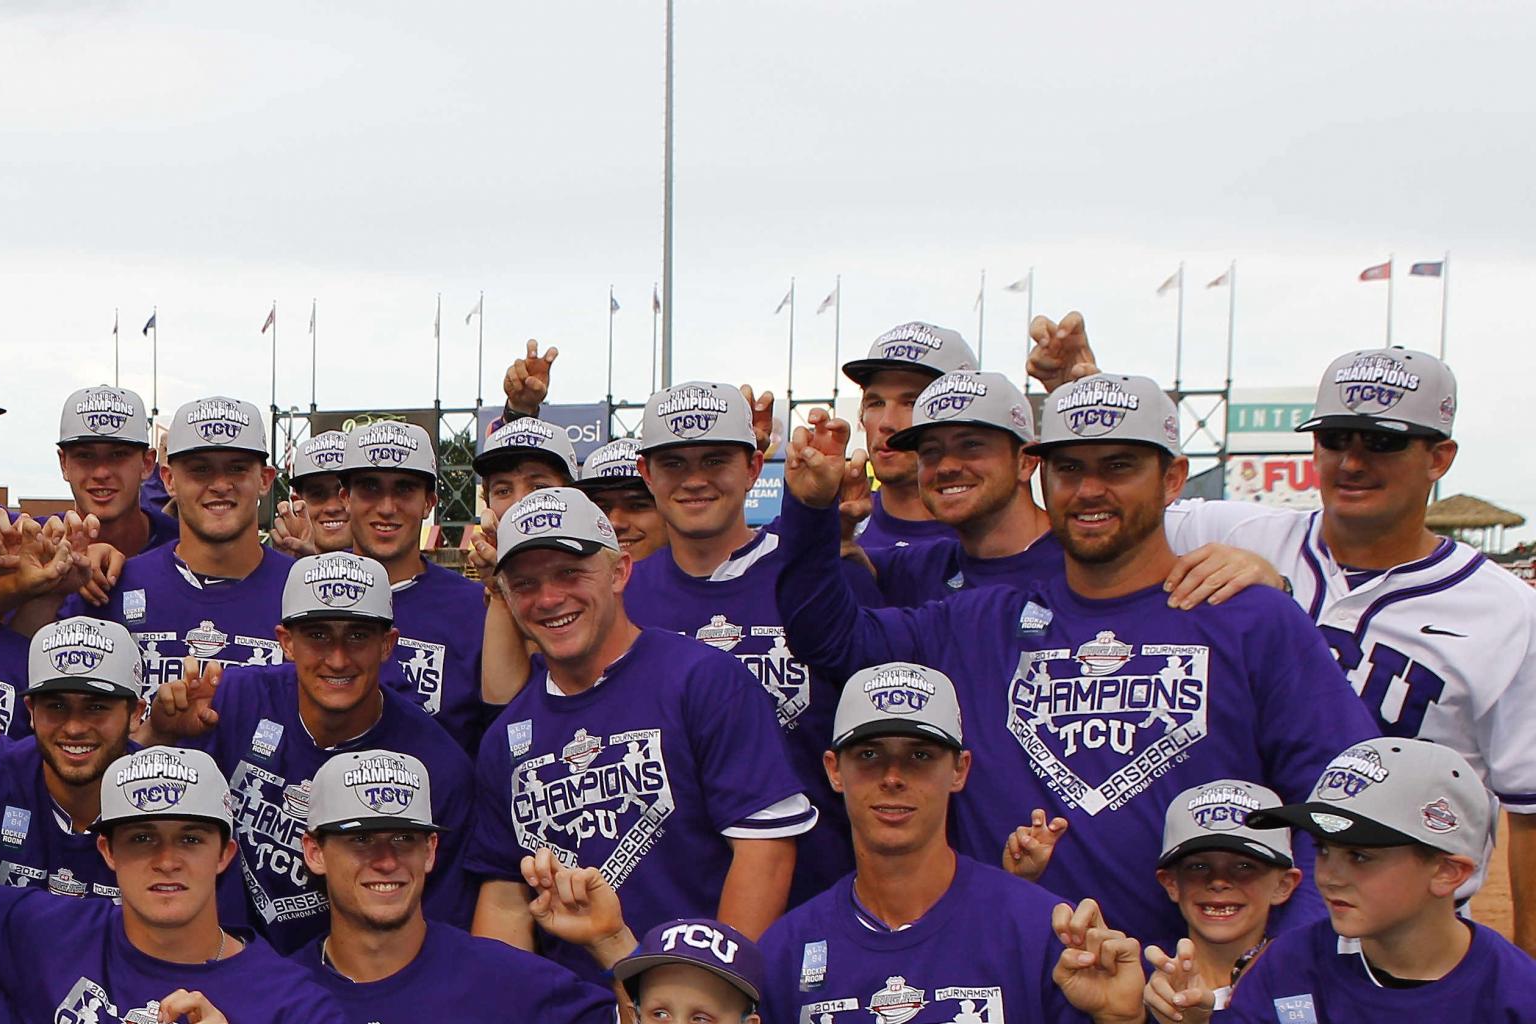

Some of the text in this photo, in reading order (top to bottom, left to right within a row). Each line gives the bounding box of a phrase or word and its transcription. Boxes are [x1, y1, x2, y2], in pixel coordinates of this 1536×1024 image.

[876, 326, 942, 350] CHAMPIONS
[1334, 367, 1420, 391] CHAMPIONS
[919, 378, 987, 407] CHAMPIONS
[1056, 389, 1139, 412] CHAMPIONS
[1346, 384, 1399, 408] TCU
[657, 395, 728, 415] CHAMPIONS
[186, 411, 249, 429] CHAMPIONS
[669, 412, 714, 433] TCU
[1069, 409, 1119, 431] TCU
[510, 499, 567, 522] CHAMPIONS
[518, 511, 563, 532] TCU
[303, 565, 375, 588] CHAMPIONS
[318, 583, 364, 603] TCU
[41, 631, 114, 655] CHAMPIONS
[55, 650, 102, 671] TCU
[863, 679, 935, 696] CHAMPIONS
[1009, 676, 1202, 718] CHAMPIONS
[1059, 719, 1135, 758] TCU
[116, 761, 198, 787] CHAMPIONS
[1101, 725, 1202, 803] BASEBALL
[343, 767, 420, 789] CHAMPIONS
[132, 786, 182, 808] TCU
[363, 786, 412, 808] TCU
[513, 760, 664, 824] CHAMPIONS
[569, 807, 620, 852] TCU
[660, 922, 739, 964] TCU
